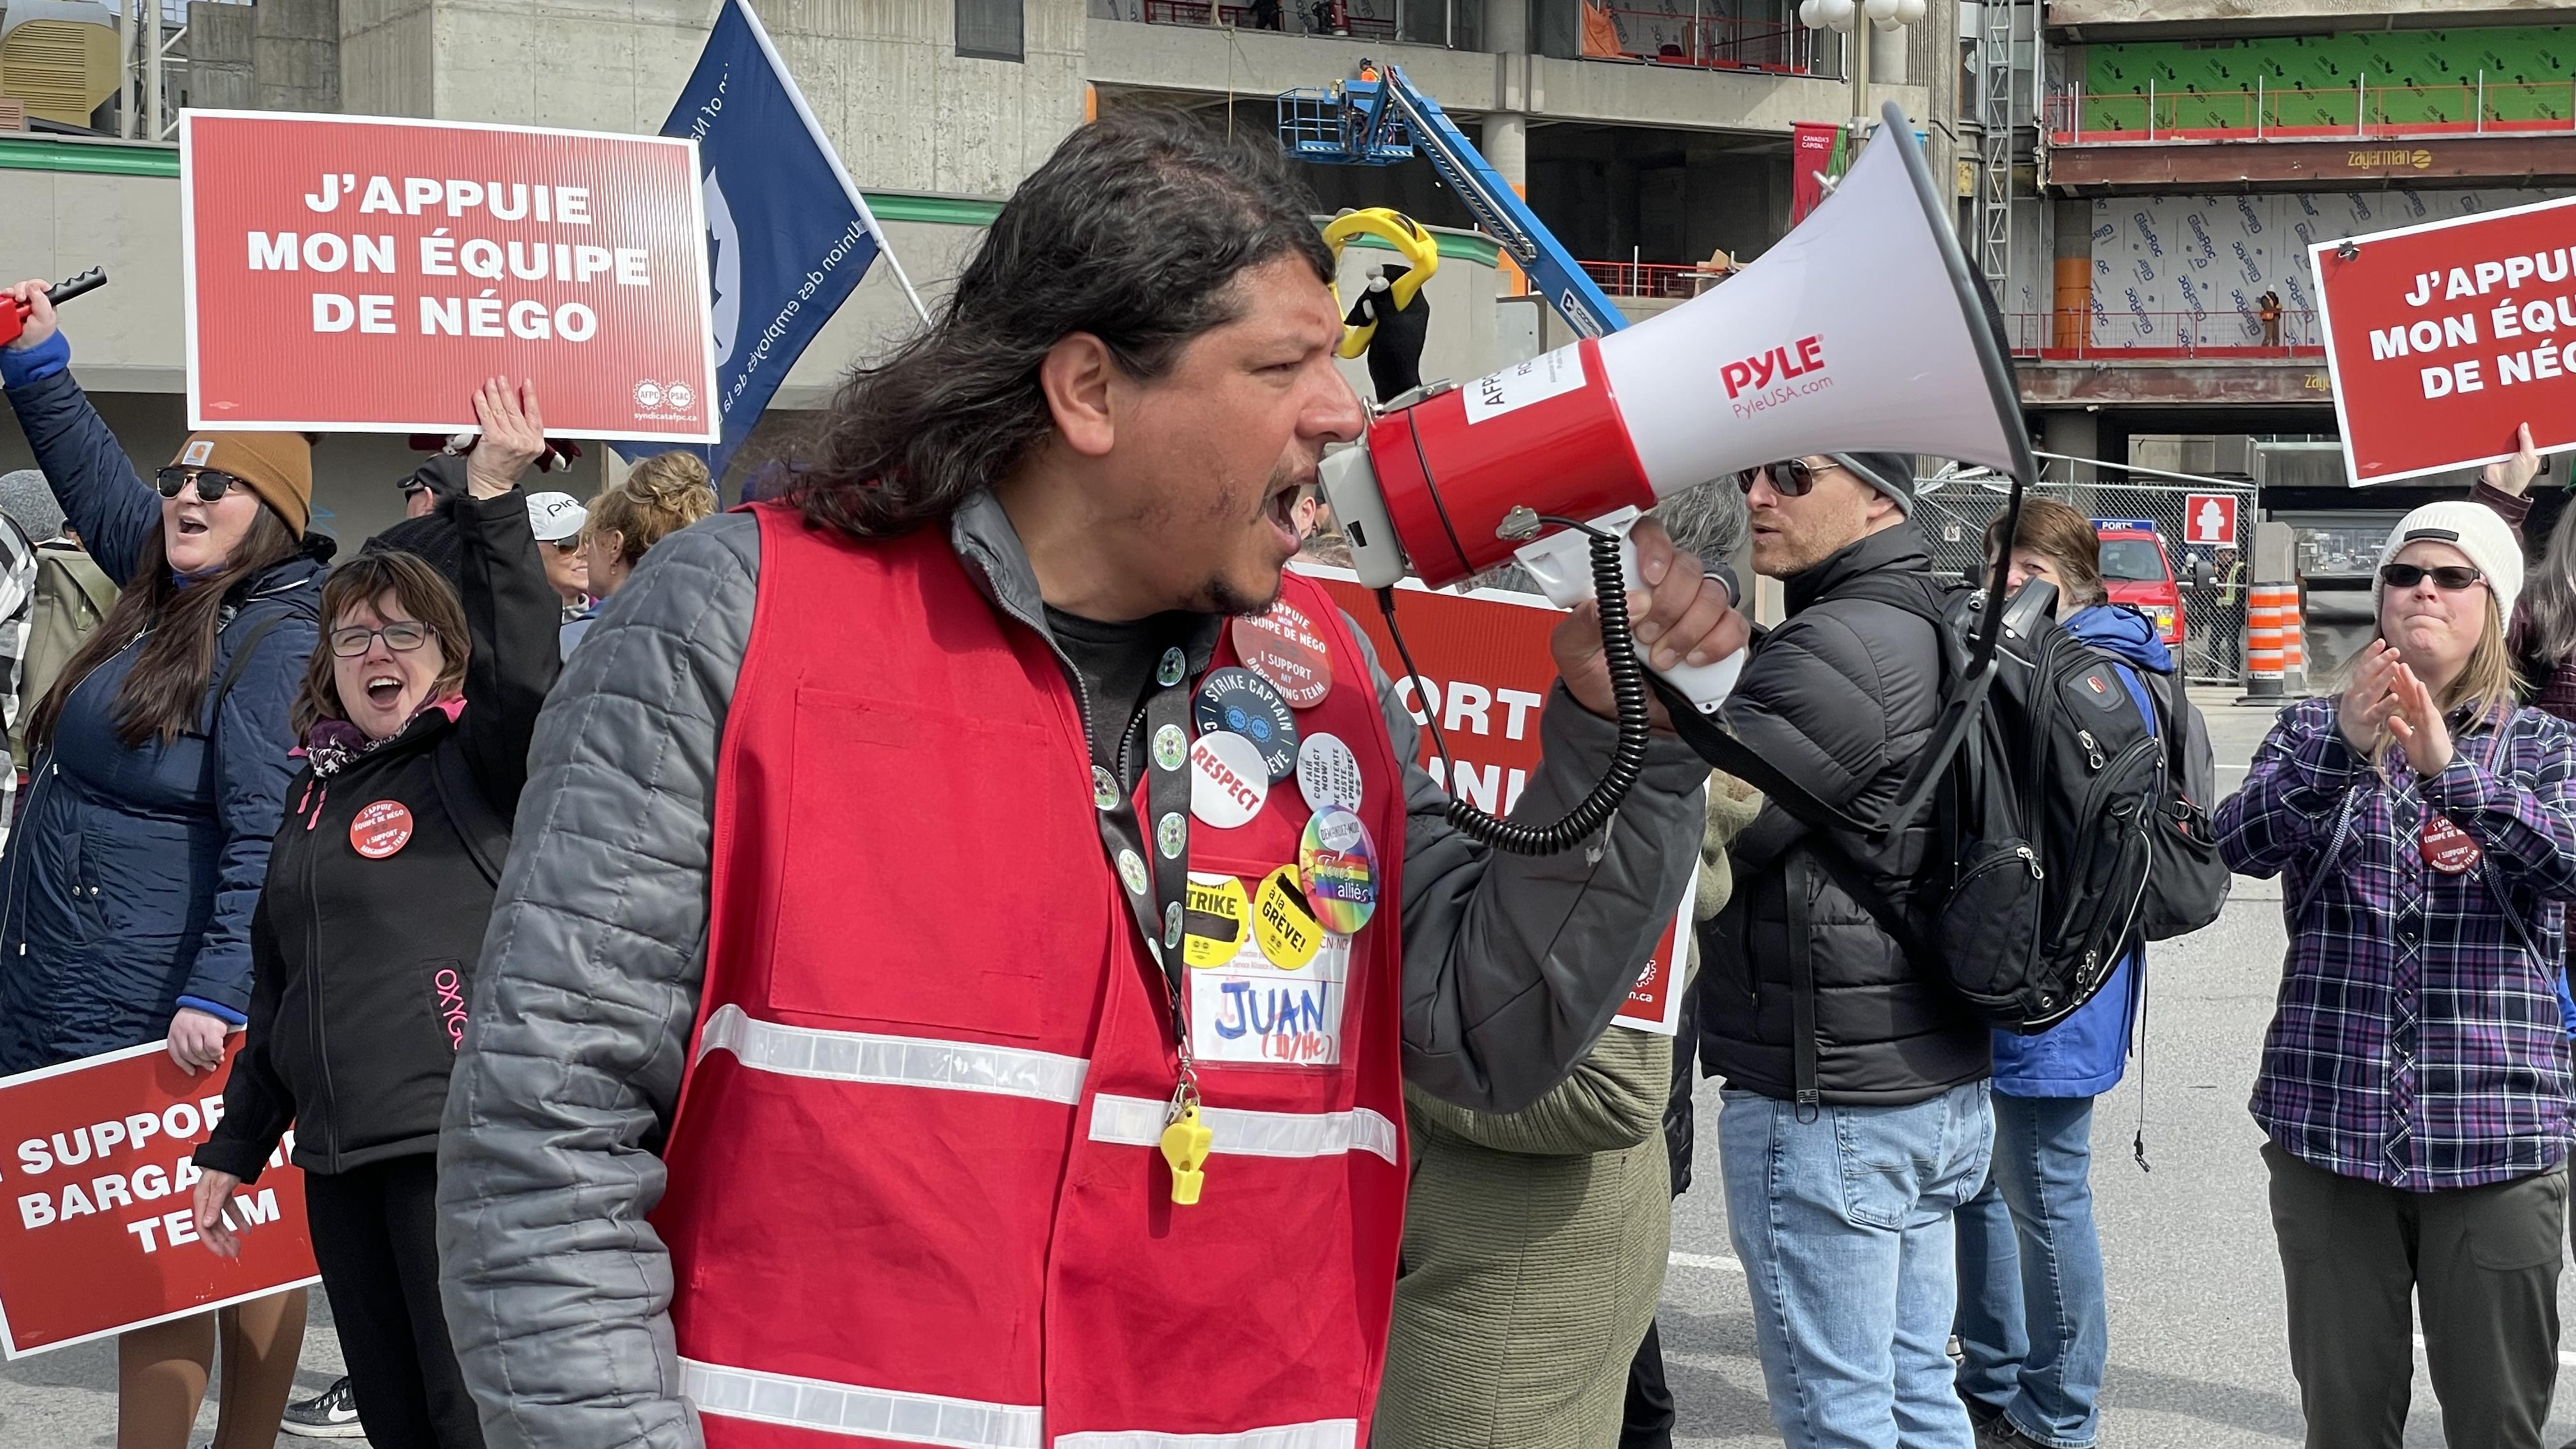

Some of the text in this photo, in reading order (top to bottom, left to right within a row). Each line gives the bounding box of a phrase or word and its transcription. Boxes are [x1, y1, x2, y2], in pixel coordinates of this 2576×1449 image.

[305, 173, 591, 224] J'APPUIE
[2134, 212, 2163, 257] GlasRoc
[2187, 214, 2216, 259] GlasRoc
[247, 227, 650, 286] MON ÉQUIPE
[312, 289, 597, 342] DE NÉGO
[2232, 289, 2260, 336] GlasRoc
[2370, 313, 2477, 361] MON
[1720, 336, 1825, 399] PYLE
[2421, 360, 2483, 399] DE
[640, 390, 689, 401] AFPC PSAC
[1732, 377, 1834, 419] PyleUSA.com
[634, 411, 698, 422] syndicatafpc.ca
[1278, 615, 1293, 627] MON
[1284, 626, 1297, 641] DE
[1300, 632, 1326, 654] NÉGO
[1261, 650, 1312, 680] I SUPPORT
[1280, 673, 1292, 684] MY
[1205, 675, 1292, 731] STRIKE CAPTAIN
[1300, 681, 1326, 701] TEAM
[1192, 745, 1259, 811] RESPECT
[371, 829, 397, 843] SUPPORT
[377, 815, 386, 823] DE
[392, 831, 408, 847] TEAM
[2442, 847, 2468, 858] SUPPORT
[1269, 887, 1285, 910] à la
[1338, 882, 1368, 901] alliés
[1262, 901, 1307, 953] GRÈVE!
[1215, 980, 1327, 1041] JUAN
